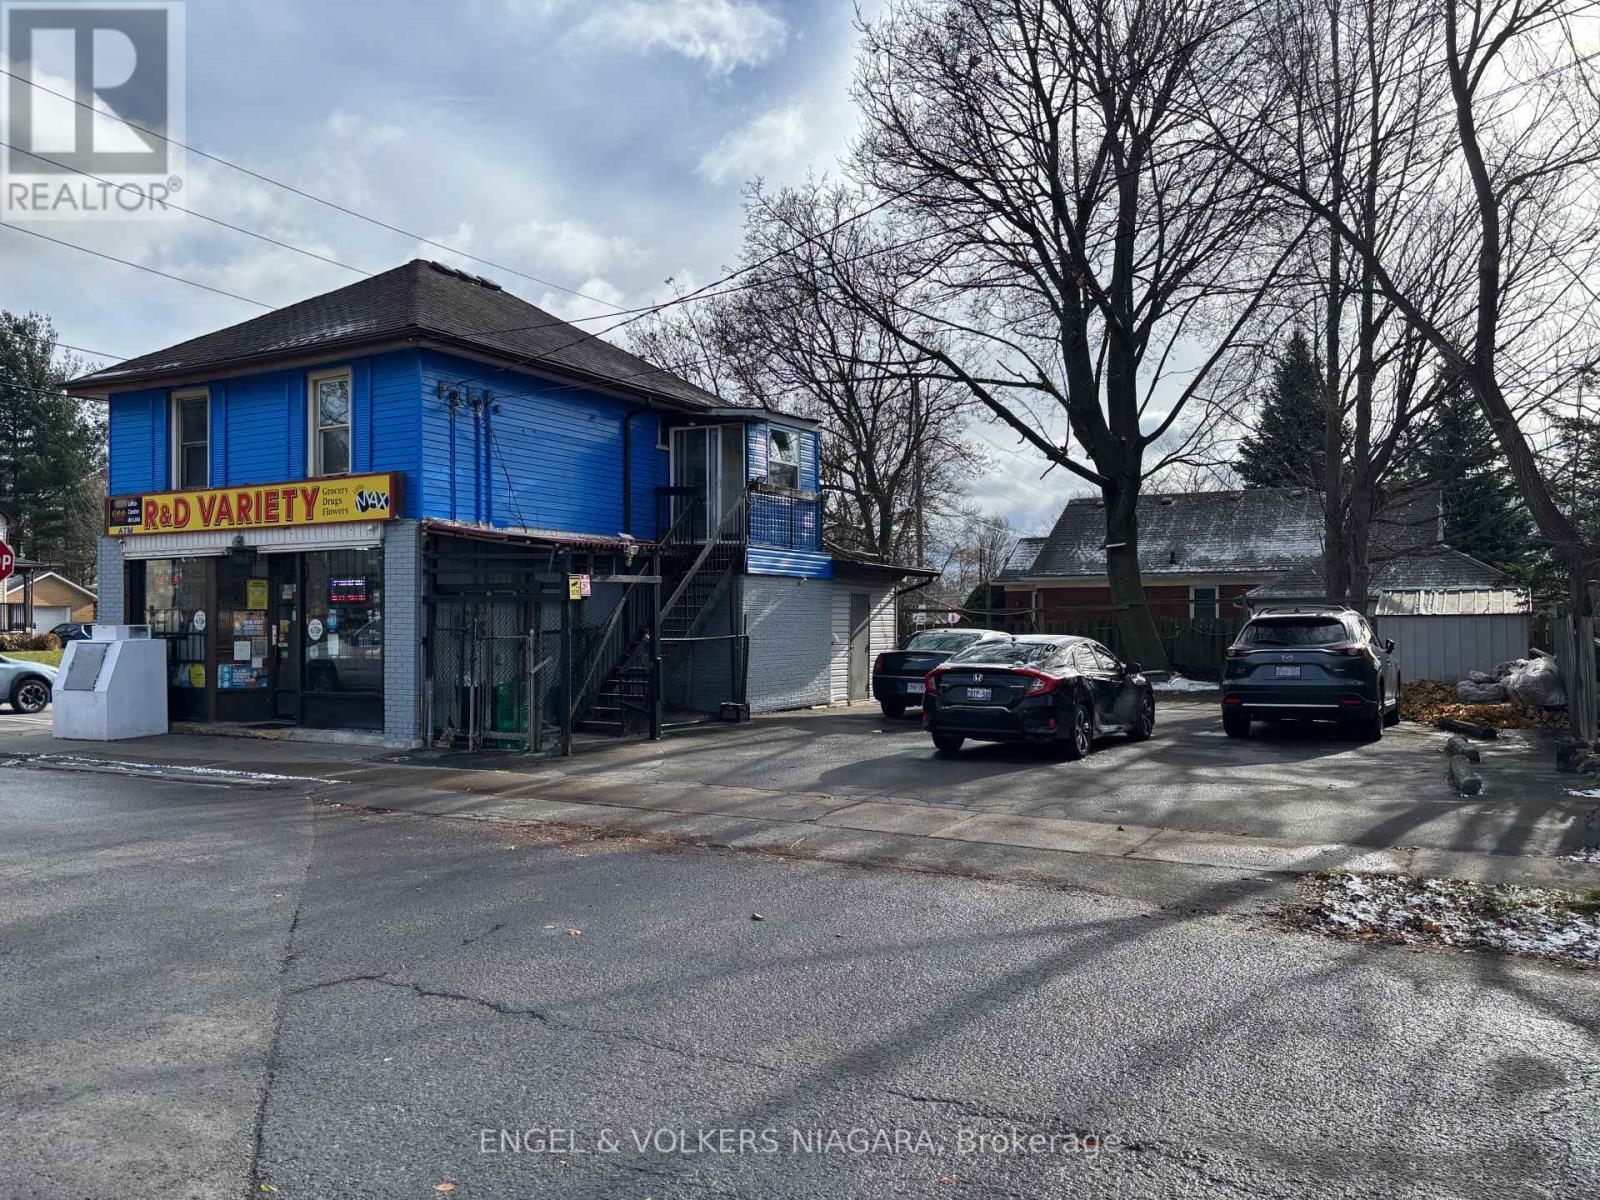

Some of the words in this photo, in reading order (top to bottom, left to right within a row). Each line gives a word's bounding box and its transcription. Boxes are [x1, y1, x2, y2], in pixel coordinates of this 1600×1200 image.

[322, 487, 350, 496] Grocery
[322, 497, 343, 506] Drugs
[355, 489, 388, 512] MAX
[143, 497, 191, 530] R&D
[197, 486, 320, 526] VARIETY
[322, 507, 349, 516] Flowers
